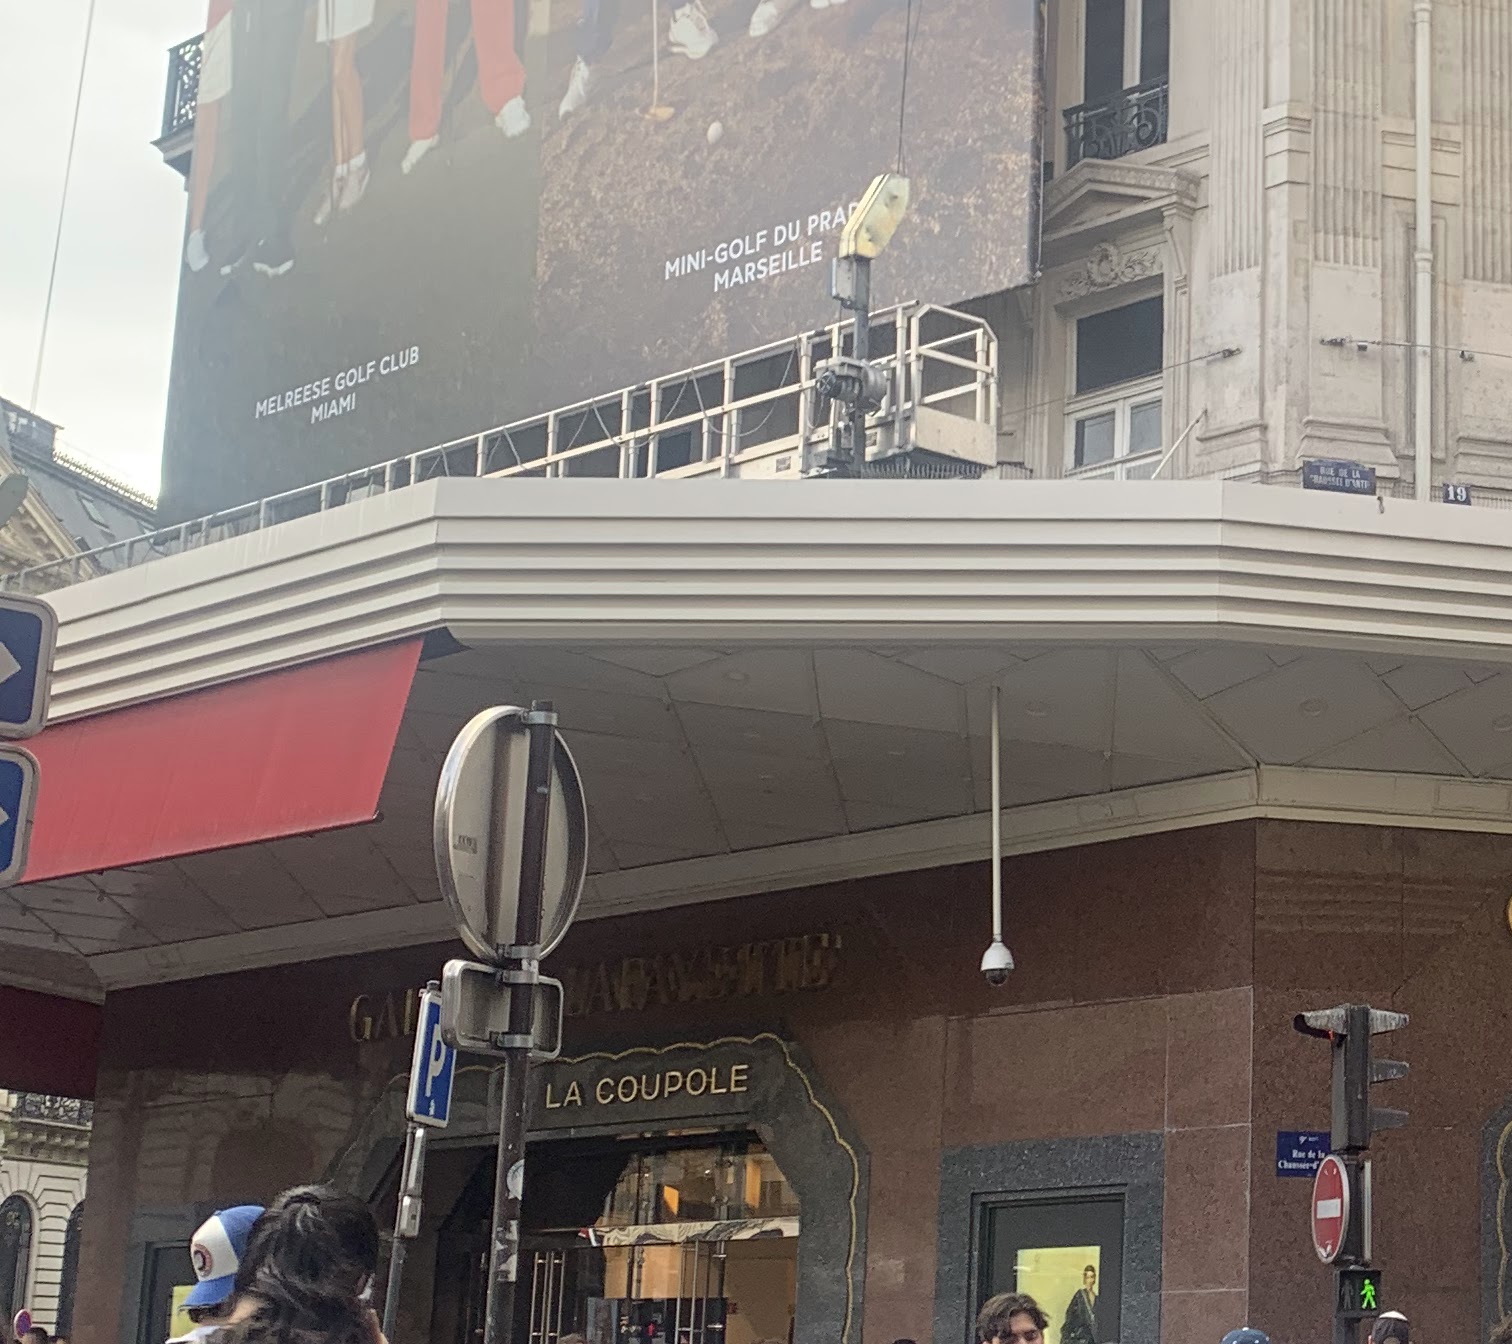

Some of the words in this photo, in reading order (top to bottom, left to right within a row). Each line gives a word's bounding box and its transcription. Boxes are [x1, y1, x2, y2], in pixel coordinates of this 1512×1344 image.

[664, 229, 768, 280] MINI-GOLF
[774, 219, 800, 247] DU
[713, 241, 823, 292] MARSEILLE
[255, 377, 331, 419] MELREESE
[335, 360, 376, 391] GOLF
[380, 346, 420, 375] CLUB
[310, 392, 356, 425] MIAMI
[1447, 485, 1467, 502] 19
[546, 1077, 582, 1109] LA
[596, 1064, 749, 1105] COUPOLE
